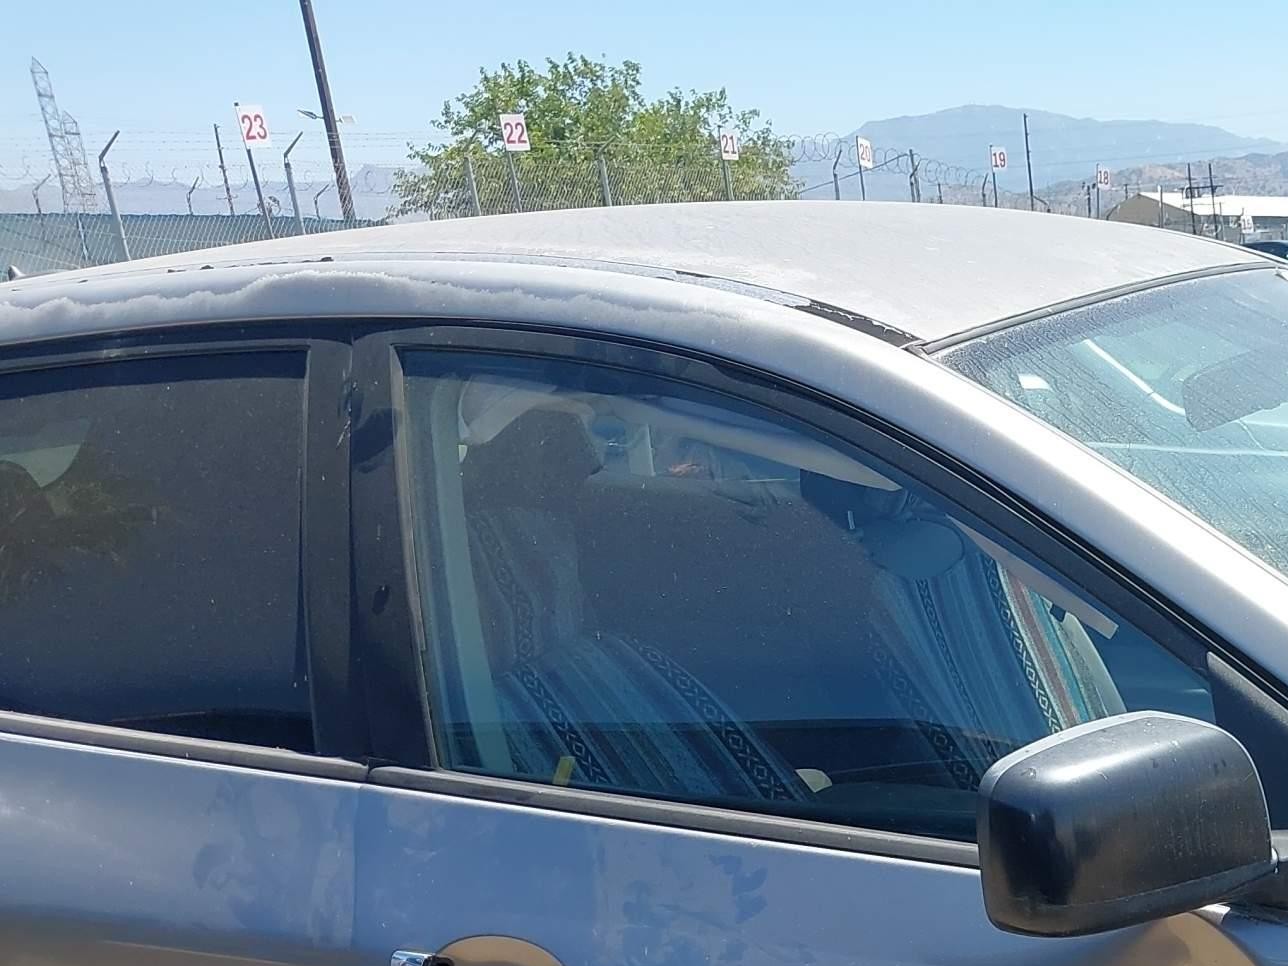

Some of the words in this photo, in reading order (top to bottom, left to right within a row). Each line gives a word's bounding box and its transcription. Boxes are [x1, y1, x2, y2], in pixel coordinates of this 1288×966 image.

[241, 114, 267, 140] 23
[503, 122, 527, 144] 22
[721, 134, 737, 154] 21
[859, 143, 871, 162] 20
[992, 151, 1006, 168] 19
[1098, 170, 1109, 185] 18
